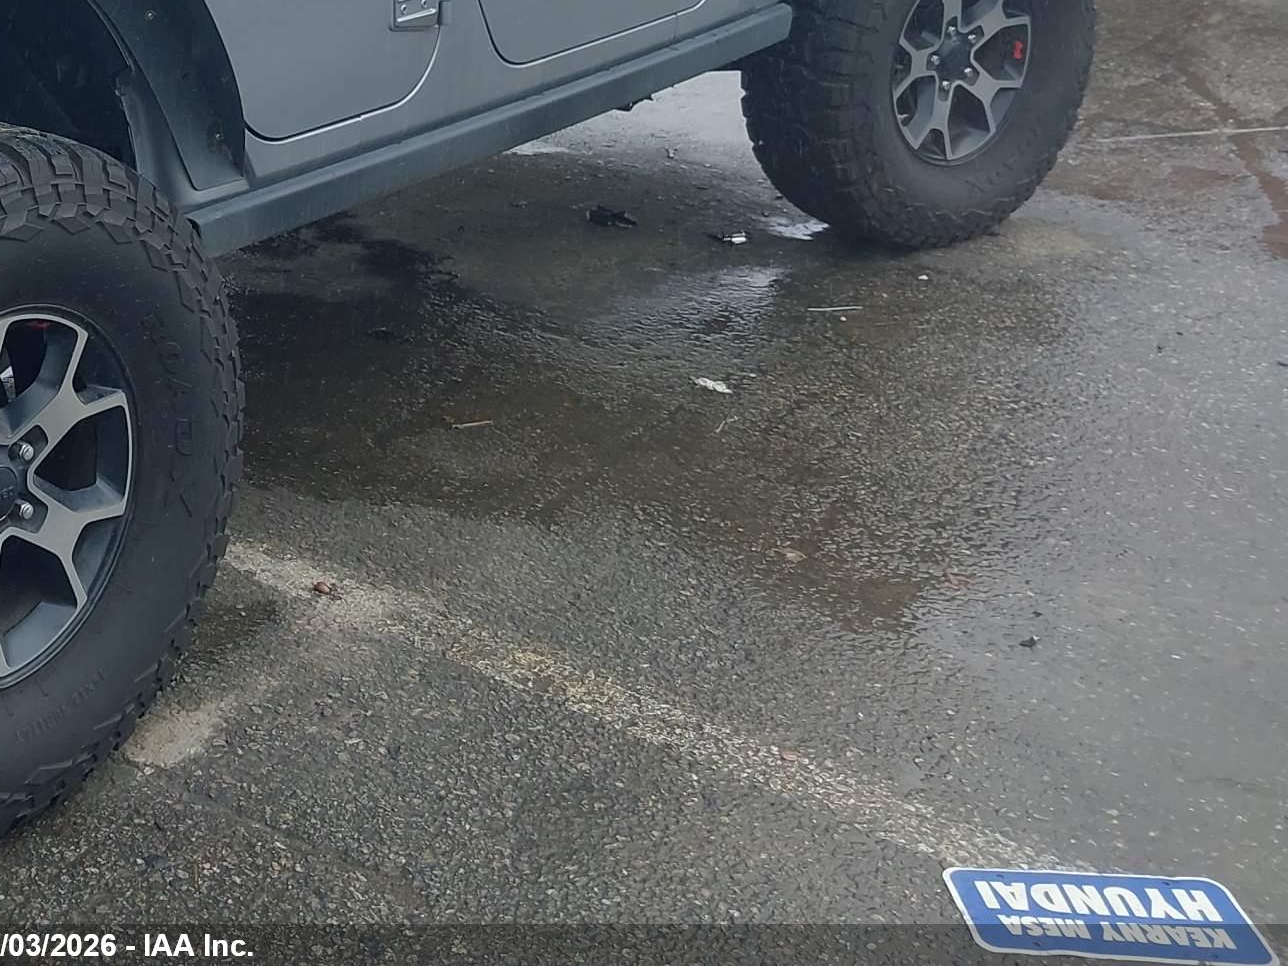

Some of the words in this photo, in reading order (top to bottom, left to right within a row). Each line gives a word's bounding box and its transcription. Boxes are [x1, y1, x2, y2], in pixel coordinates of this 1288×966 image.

[973, 879, 1224, 923] HYUNDAI
[997, 913, 1090, 939] MESA
[1100, 923, 1237, 949] KEARNY
